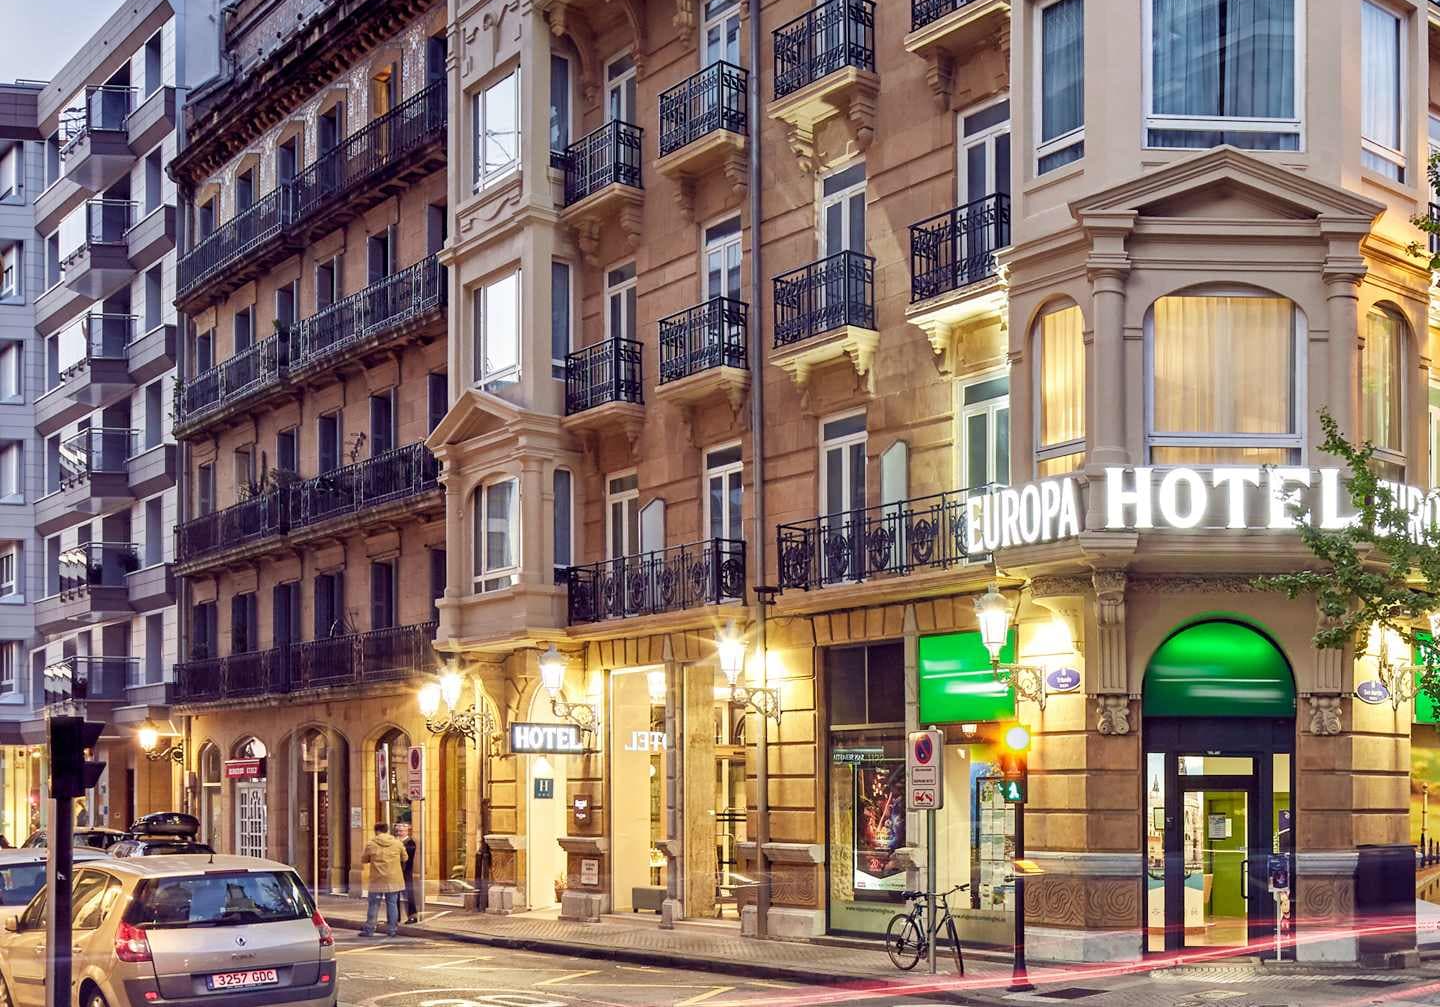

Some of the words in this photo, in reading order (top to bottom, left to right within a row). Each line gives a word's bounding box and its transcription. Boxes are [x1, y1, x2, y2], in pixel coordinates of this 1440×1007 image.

[1105, 467, 1363, 529] HOTEL
[967, 477, 1079, 554] EUROPA
[514, 725, 582, 750] HOTEL
[540, 780, 548, 792] H
[218, 972, 247, 986] 3257
[252, 970, 274, 983] GDC
